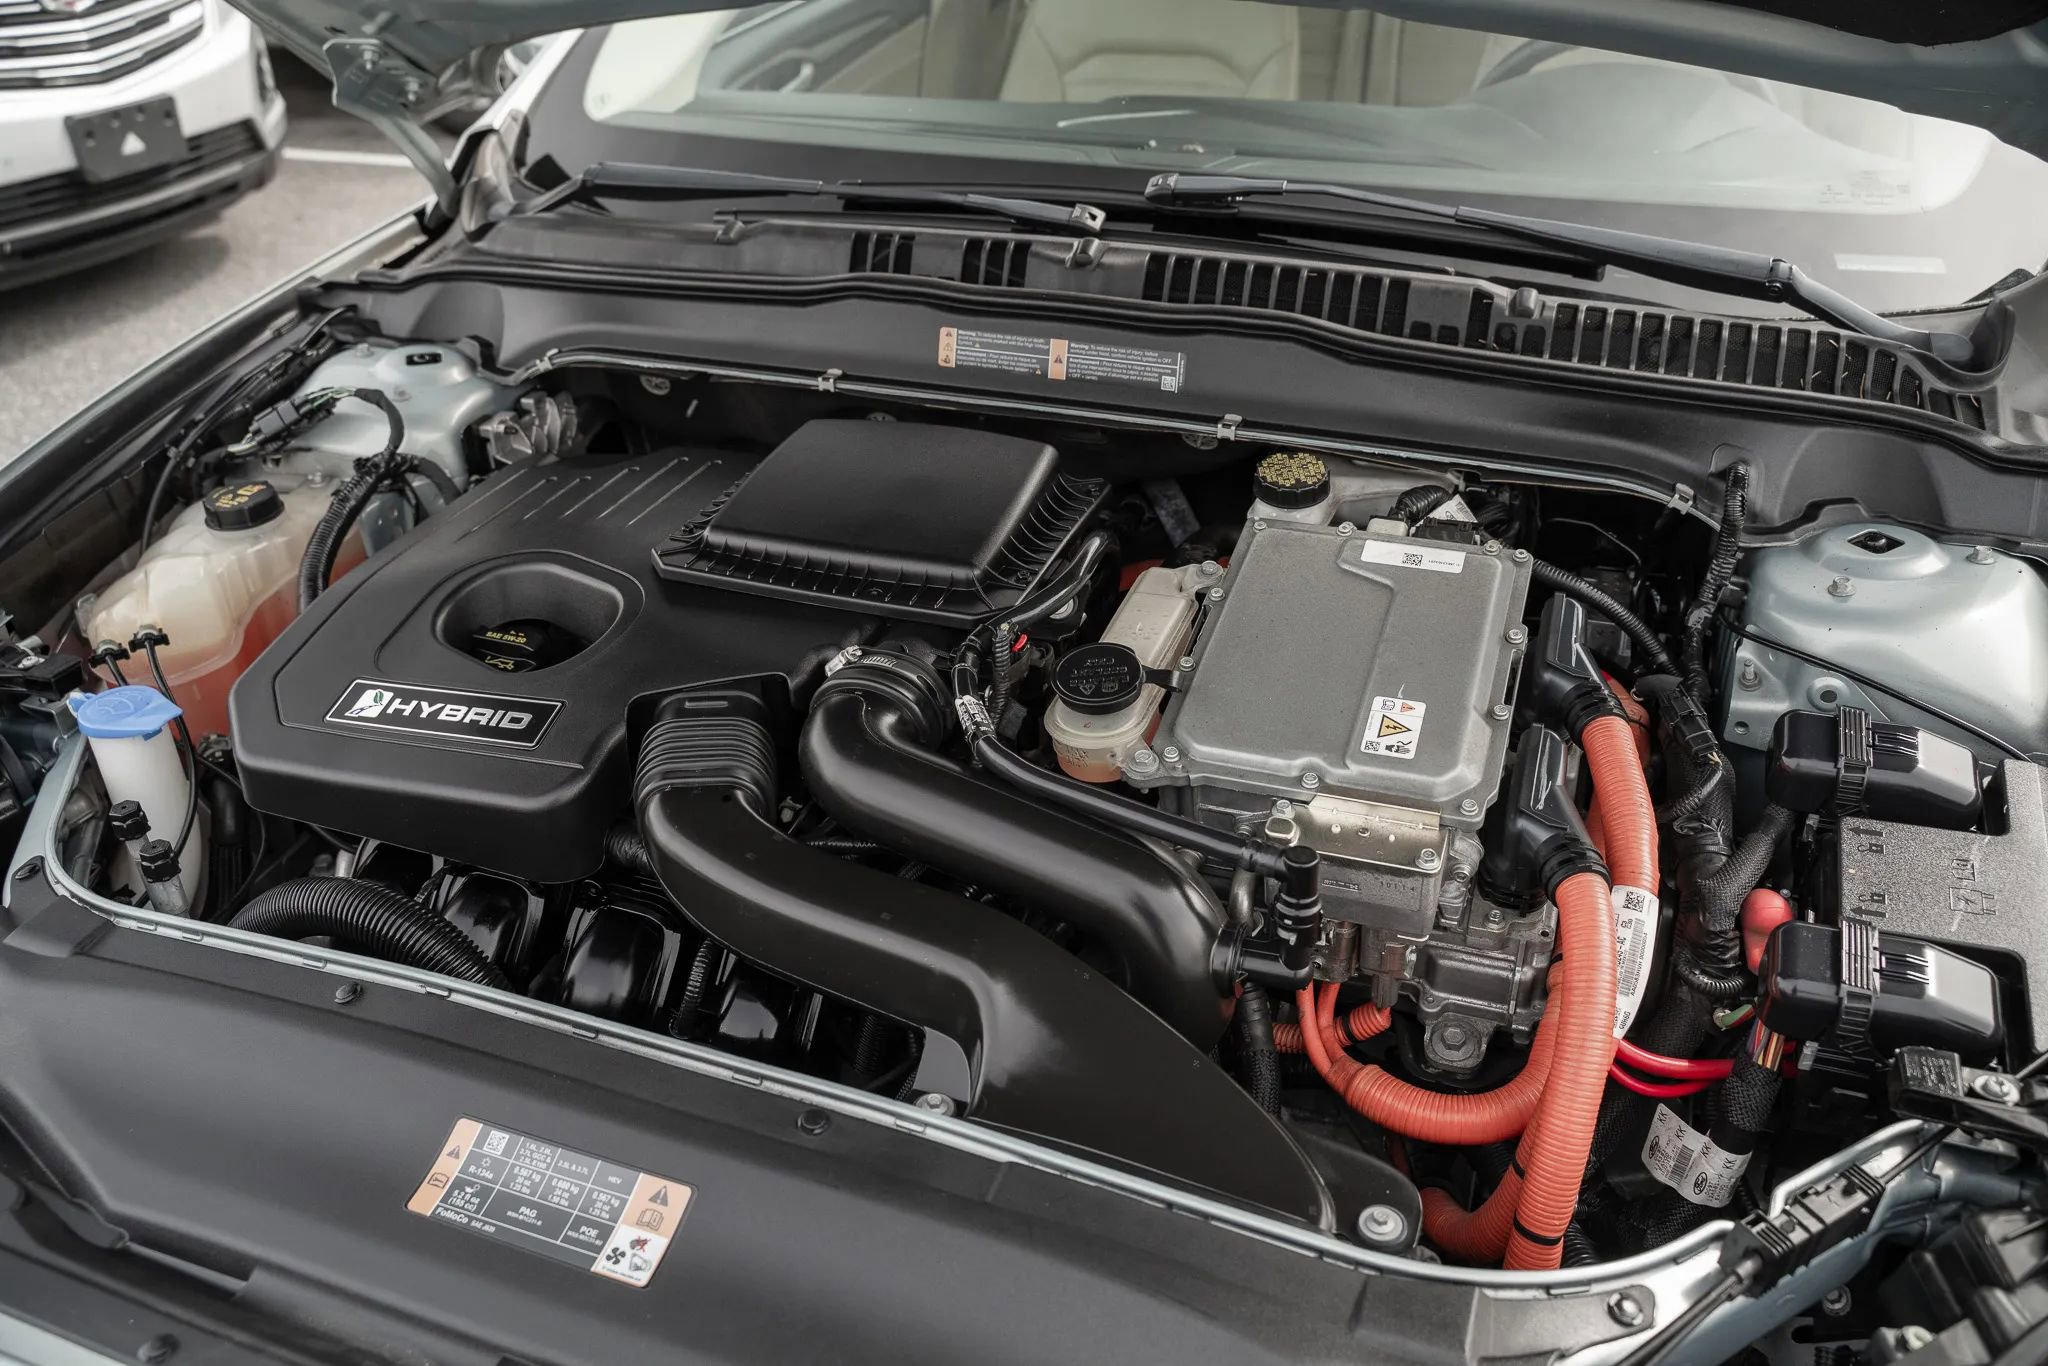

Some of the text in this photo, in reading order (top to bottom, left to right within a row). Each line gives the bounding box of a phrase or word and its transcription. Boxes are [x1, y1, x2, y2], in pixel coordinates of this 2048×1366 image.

[486, 631, 527, 643] SAE 5W-20
[386, 698, 533, 730] HYBRID
[1657, 1109, 1667, 1124] KK
[1675, 1125, 1686, 1141] KK
[1700, 1142, 1711, 1158] KK
[532, 1153, 545, 1161] GCC
[1722, 1158, 1736, 1169] KK
[469, 1165, 493, 1178] R-134a
[530, 1173, 541, 1182] kg
[607, 1176, 621, 1185] HEV
[452, 1190, 465, 1199] 5.2
[569, 1185, 579, 1194] kg
[449, 1196, 476, 1212] (155 cc)
[609, 1198, 619, 1208] kg
[519, 1206, 536, 1217] PAG
[436, 1207, 468, 1223] FoMoCo
[470, 1220, 482, 1229] SAE
[580, 1226, 597, 1237] POE
